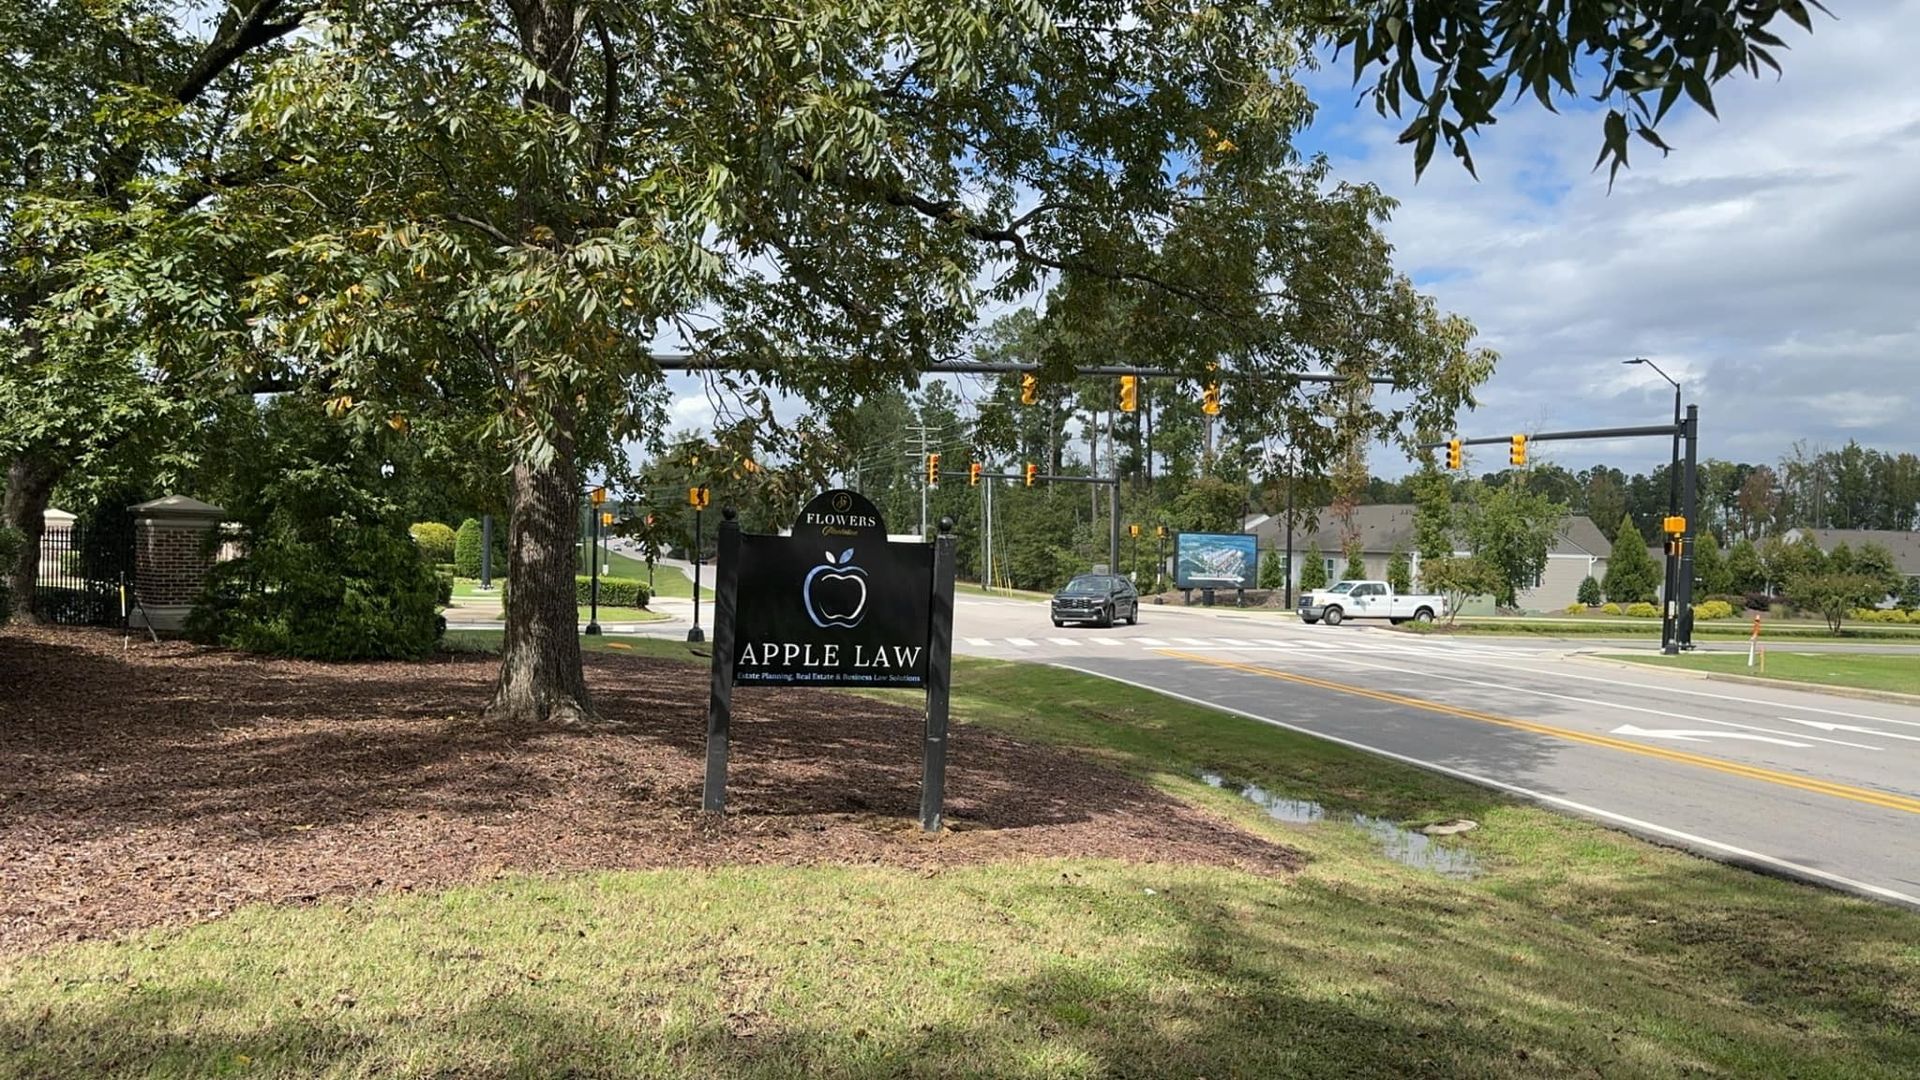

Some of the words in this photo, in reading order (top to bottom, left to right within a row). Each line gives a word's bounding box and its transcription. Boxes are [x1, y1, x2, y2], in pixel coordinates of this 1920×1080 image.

[807, 513, 876, 527] FLOWERS
[738, 642, 840, 666] APPLE
[854, 645, 922, 668] LAW
[796, 672, 811, 680] Real
[812, 672, 834, 680] Estate
[842, 673, 872, 681] Business
[888, 674, 921, 682] Solutions
